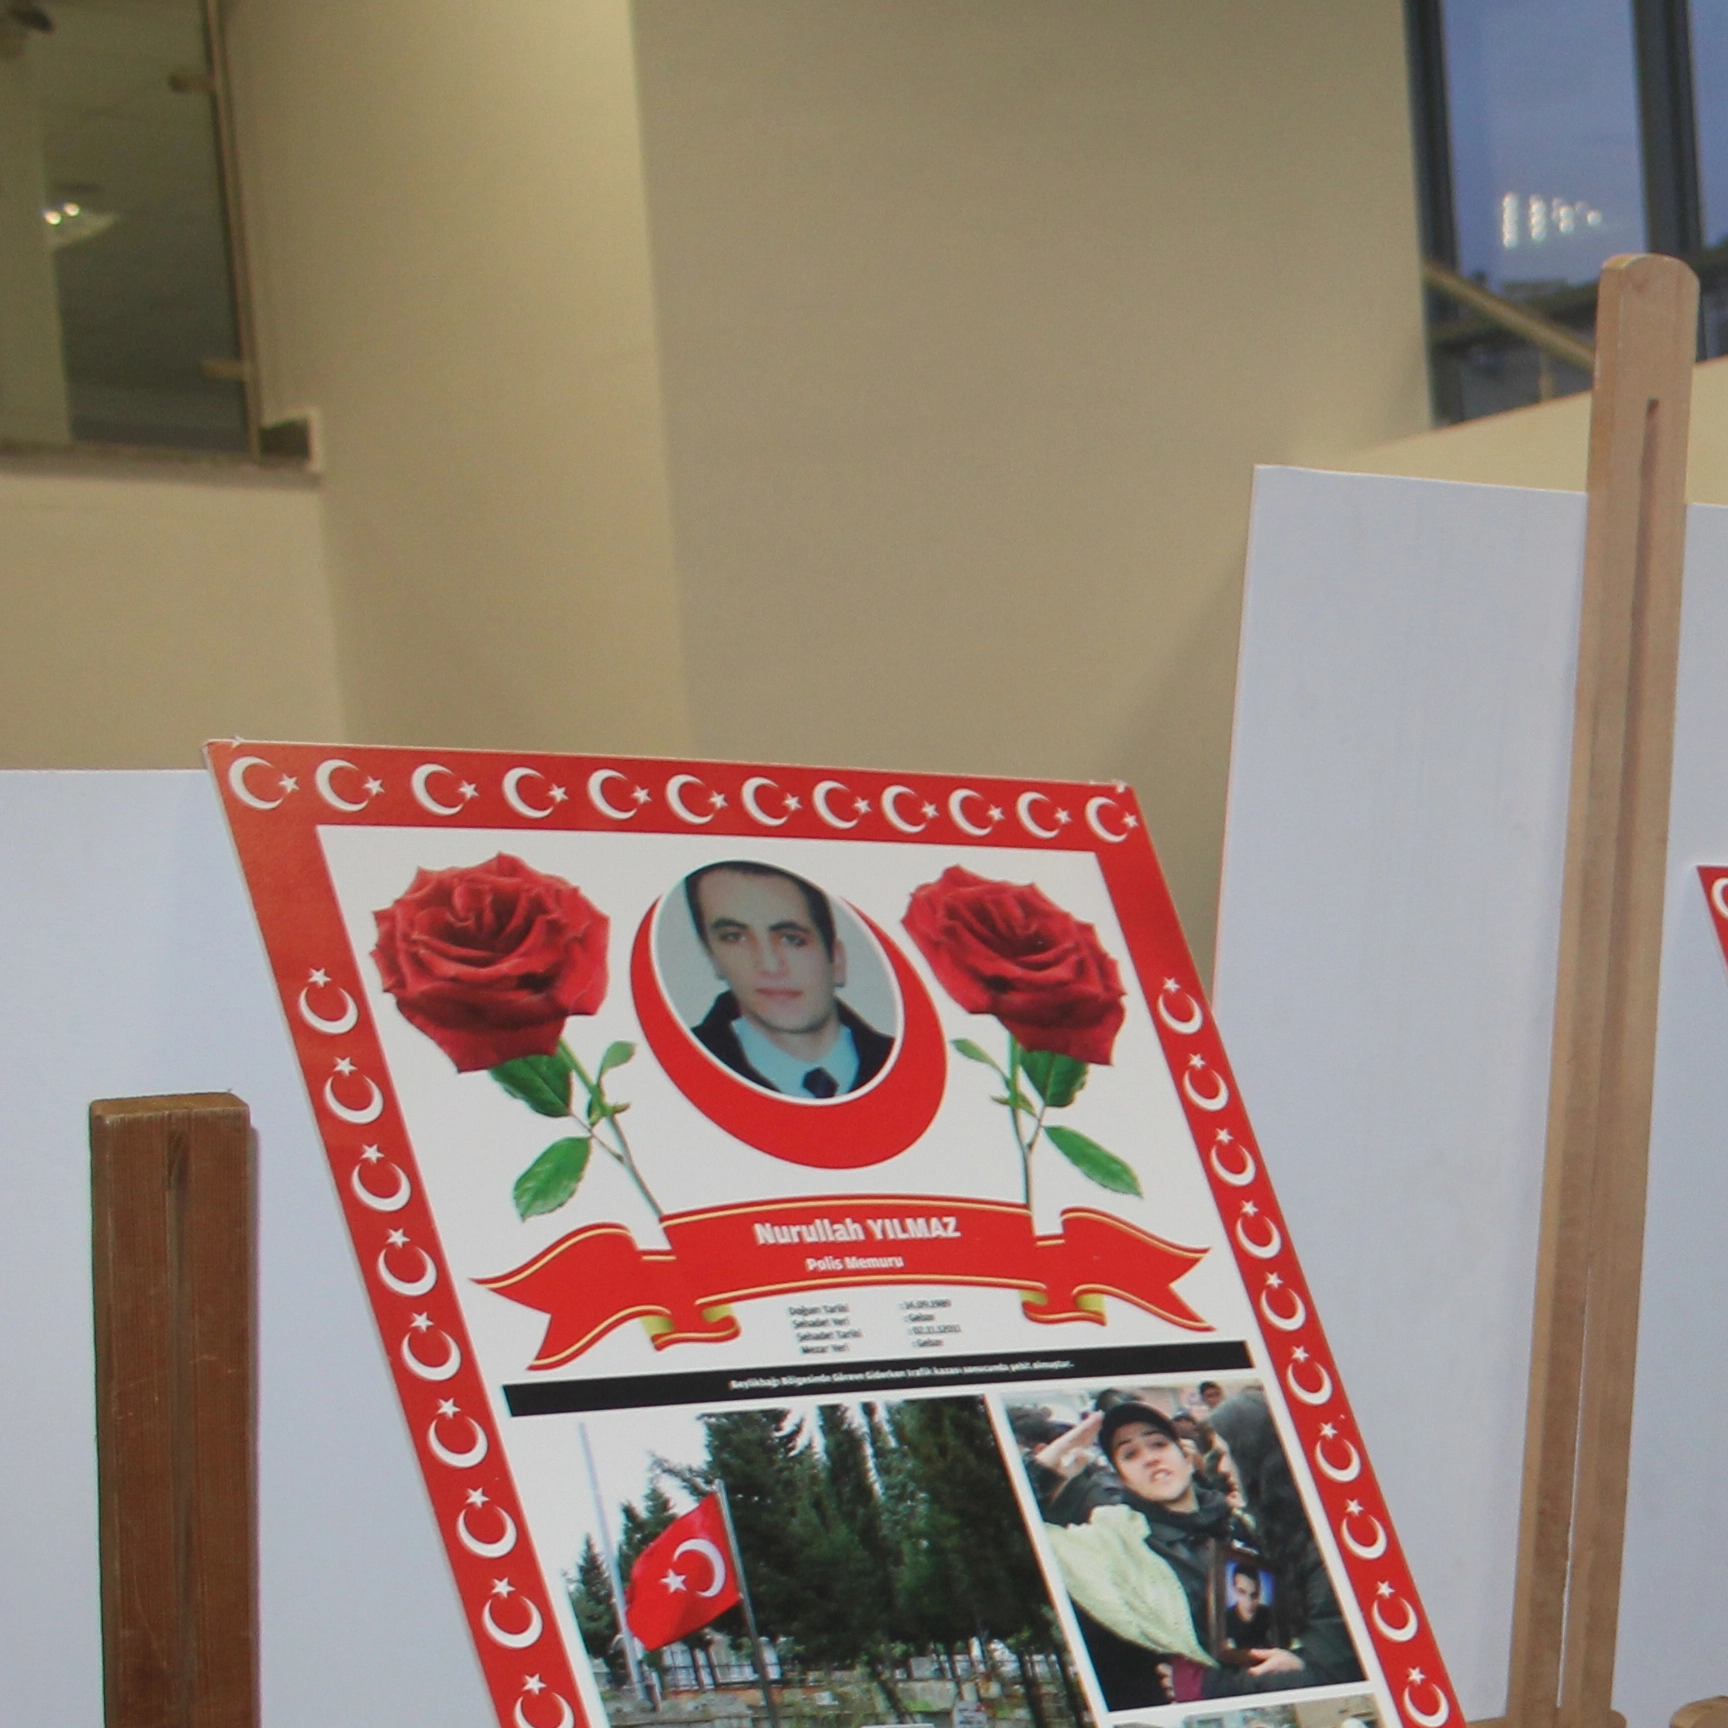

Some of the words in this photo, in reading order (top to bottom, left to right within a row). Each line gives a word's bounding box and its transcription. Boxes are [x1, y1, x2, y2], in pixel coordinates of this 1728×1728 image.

[753, 1218, 865, 1245] Nurullah
[866, 1216, 962, 1241] YILMAZ
[805, 1256, 844, 1271] Polis
[845, 1255, 904, 1269] Memuru
